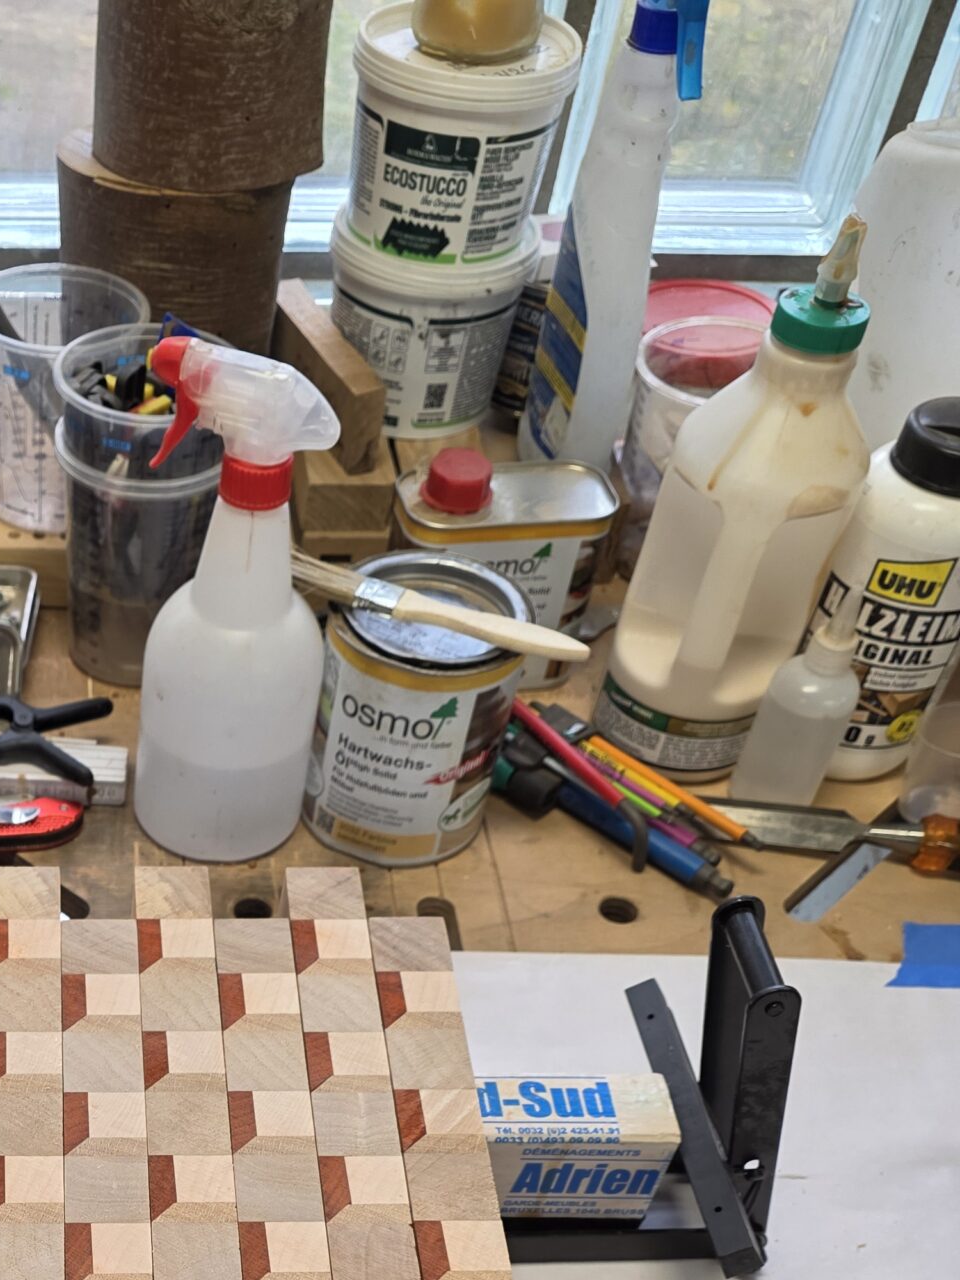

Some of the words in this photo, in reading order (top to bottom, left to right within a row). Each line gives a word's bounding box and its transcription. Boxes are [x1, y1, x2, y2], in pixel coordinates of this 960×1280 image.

[383, 162, 468, 197] ECOSTUCCO
[877, 568, 937, 600] UHU
[342, 694, 434, 741] osmo
[338, 732, 433, 772] Hartwachs-
[518, 1127, 544, 1135] 0032
[510, 1161, 661, 1195] Adrien
